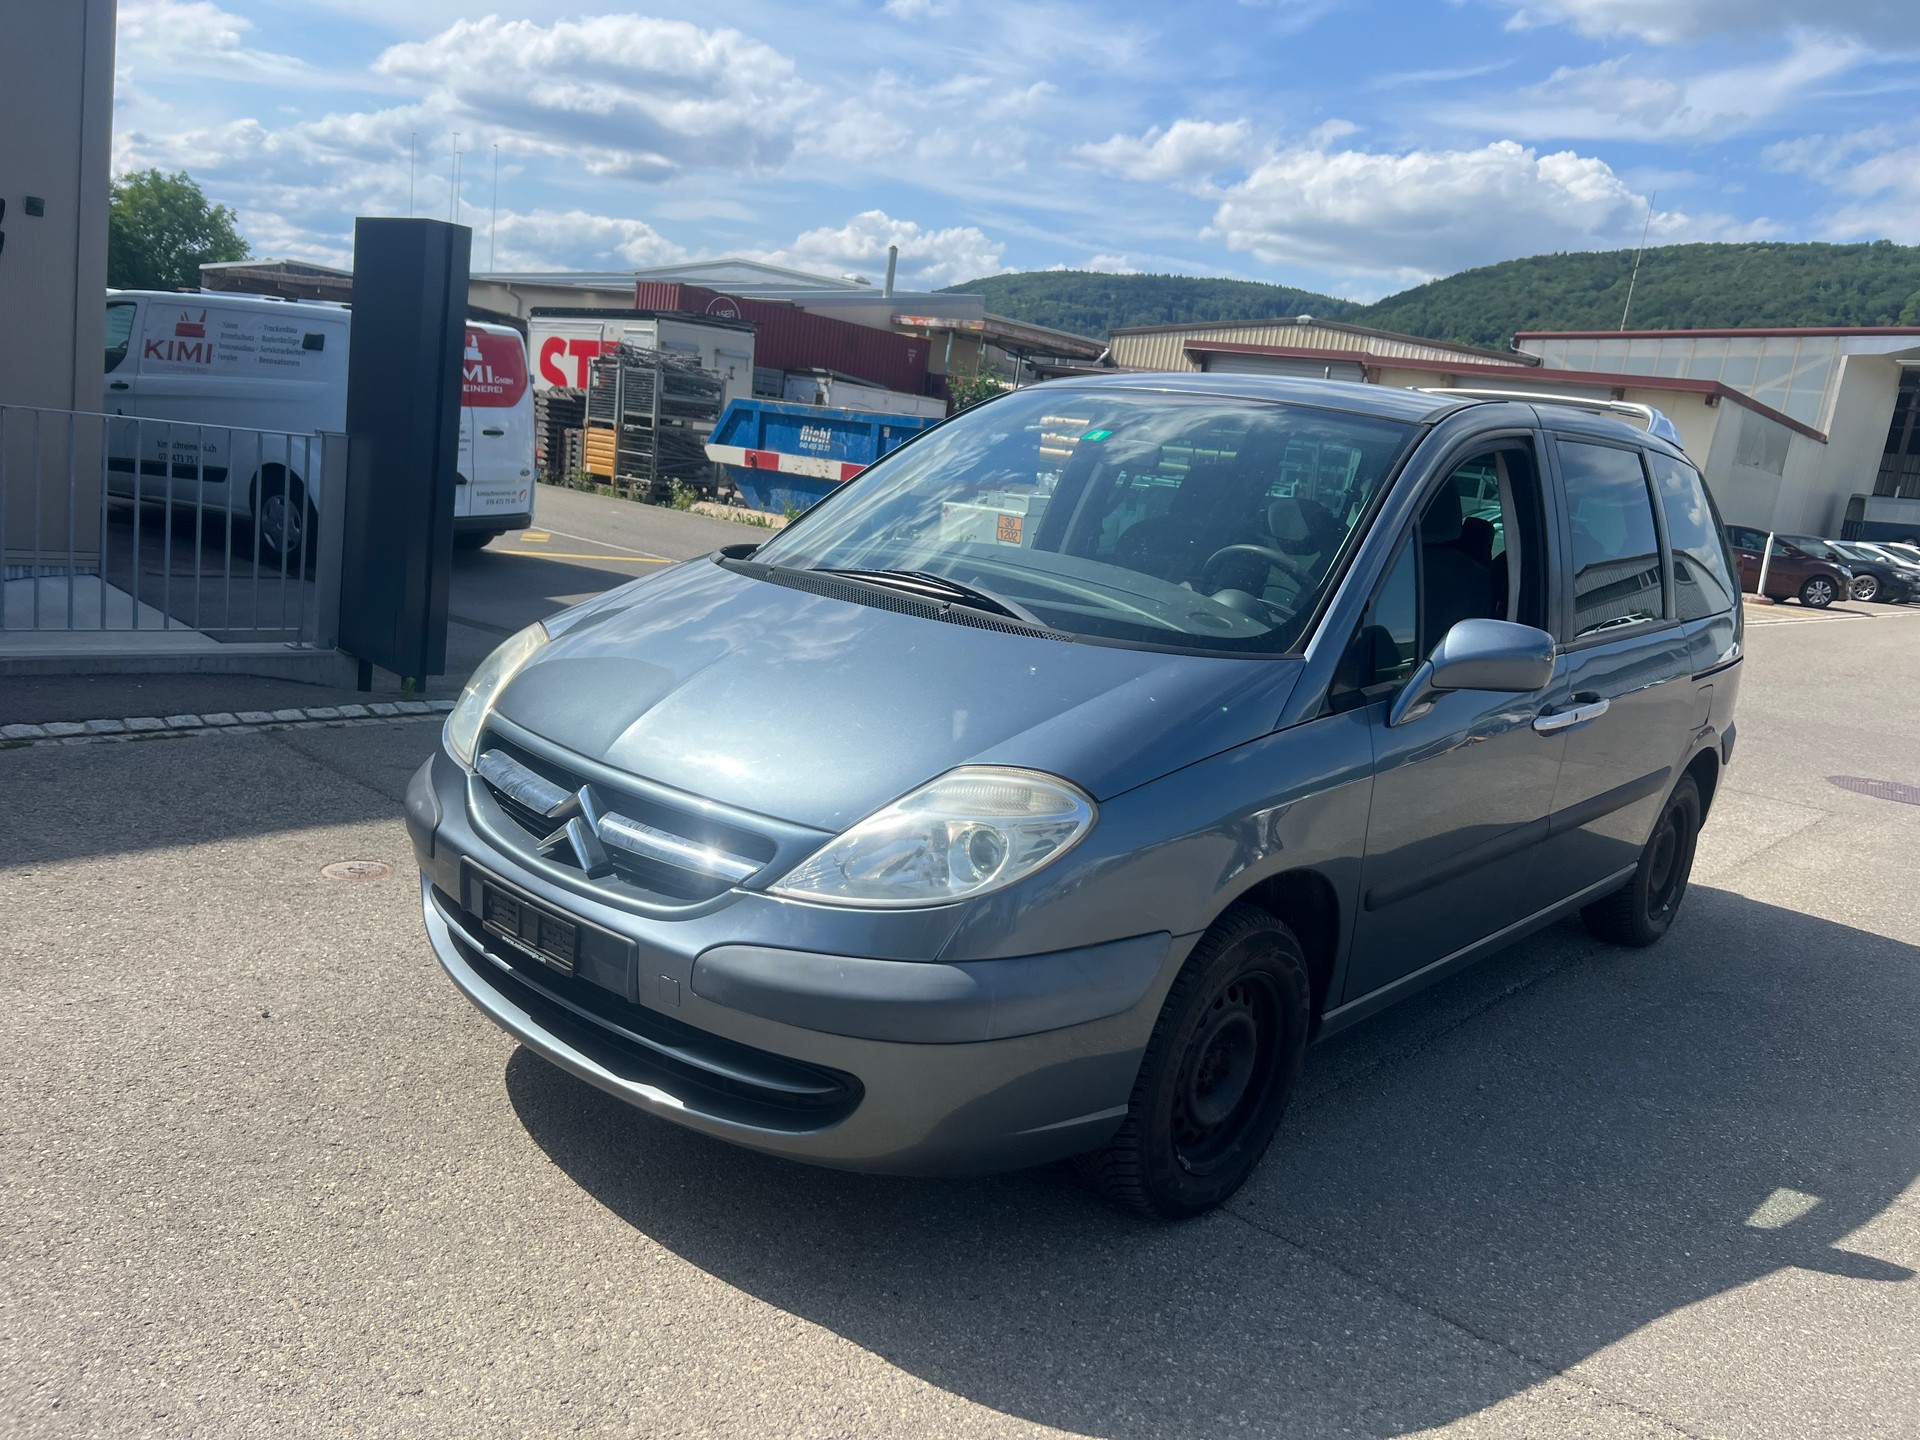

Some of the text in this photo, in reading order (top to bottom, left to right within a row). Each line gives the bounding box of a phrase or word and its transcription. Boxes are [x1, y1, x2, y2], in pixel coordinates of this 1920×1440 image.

[264, 325, 298, 334] Trockenbau
[143, 338, 213, 364] KIMI
[258, 357, 300, 367] Renovationen
[463, 365, 493, 383] MI
[463, 385, 503, 393] EINEREI
[1005, 518, 1015, 528] 30
[1000, 530, 1018, 541] 1202
